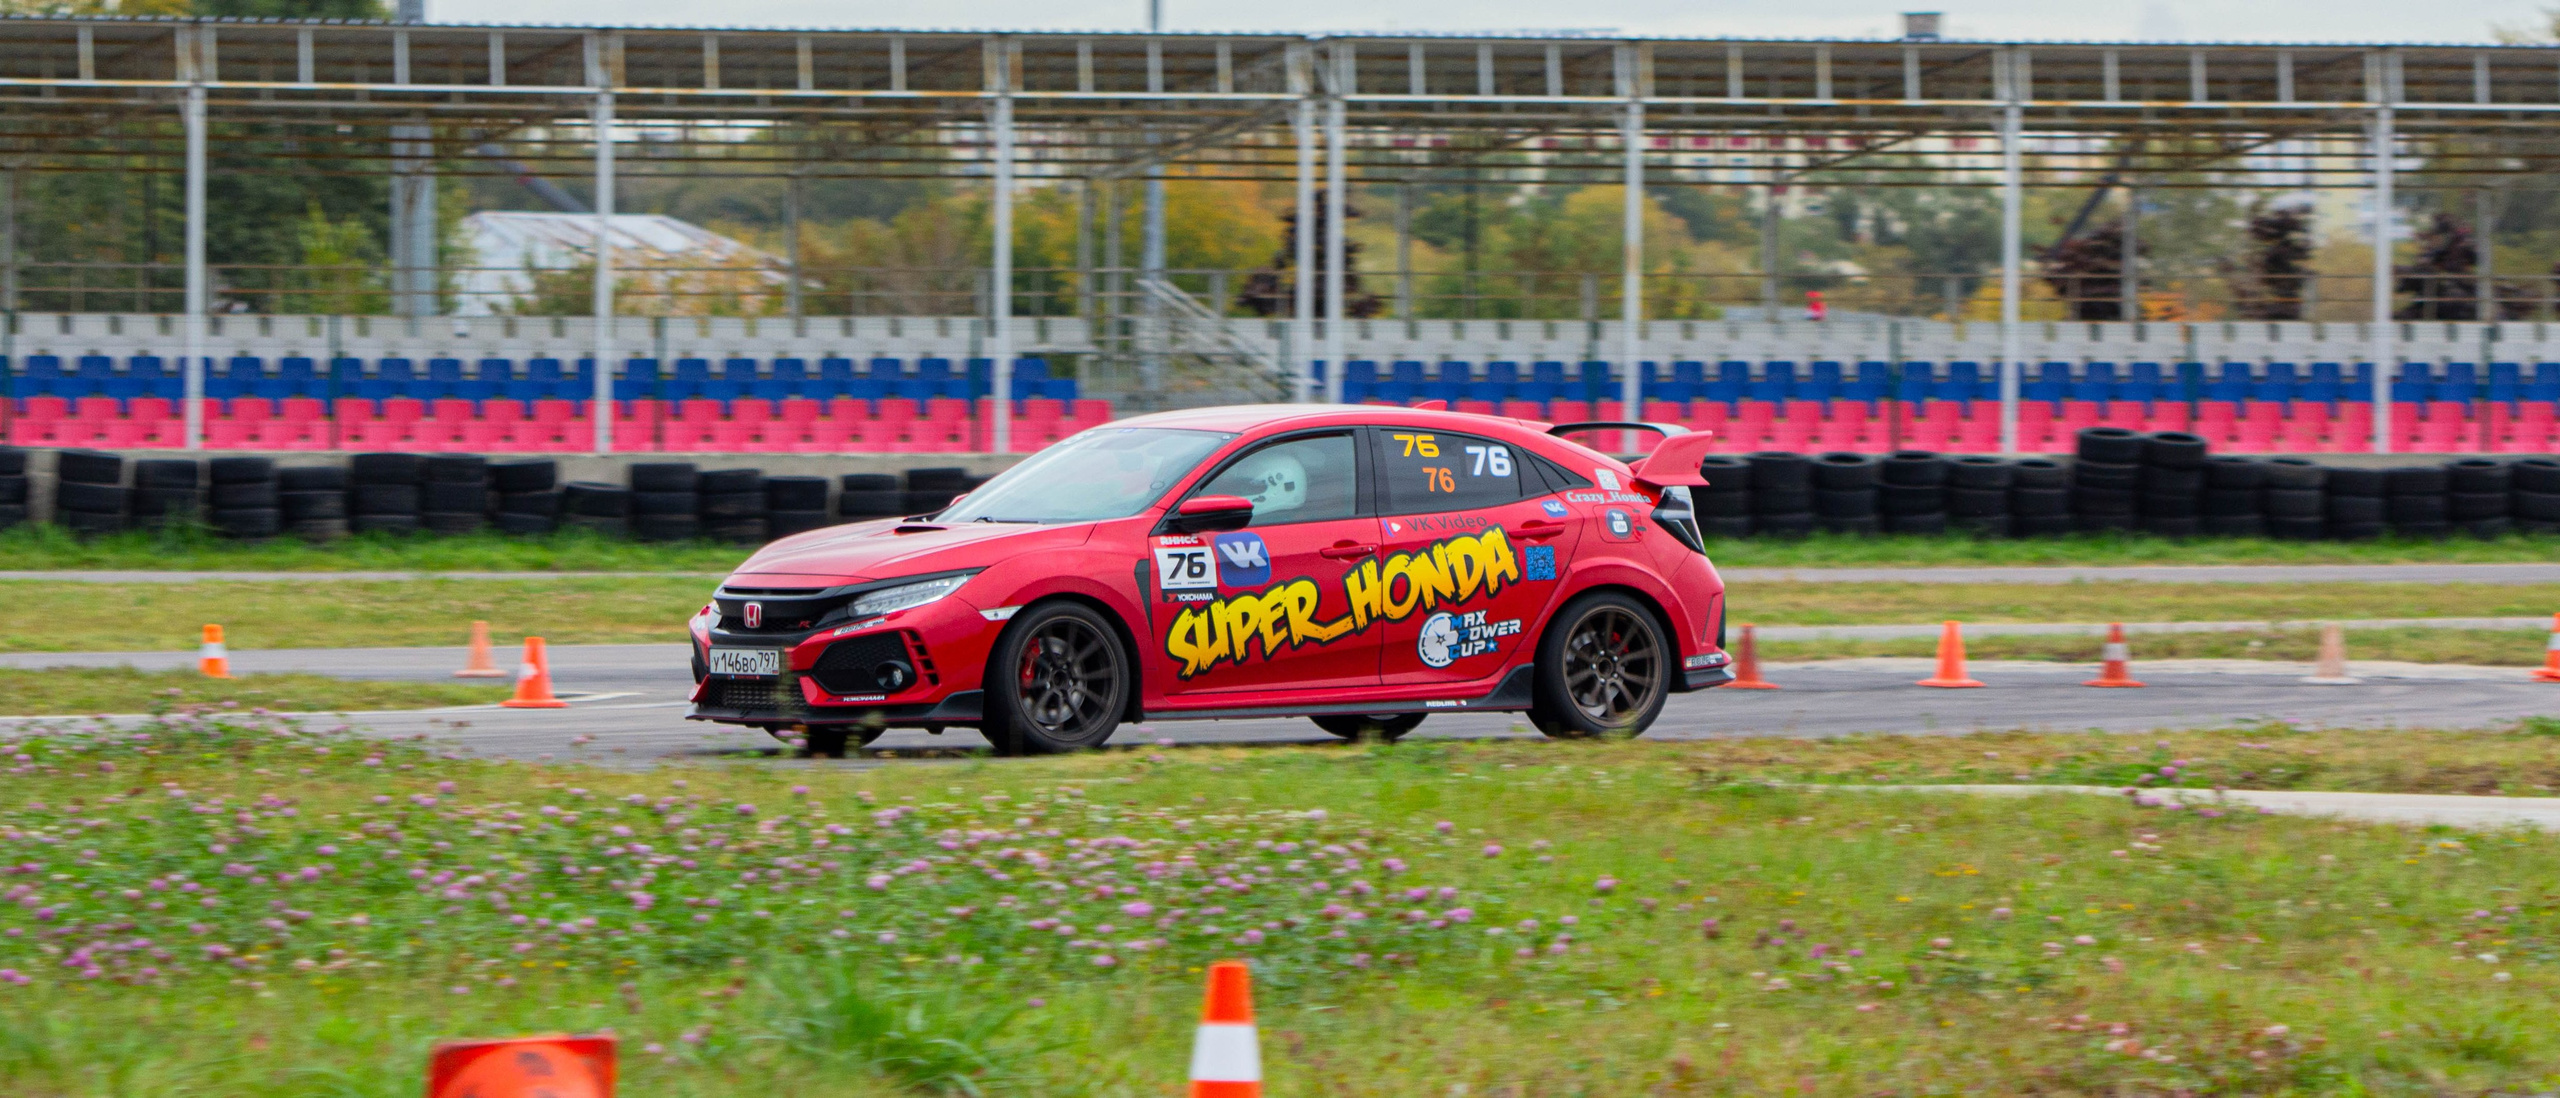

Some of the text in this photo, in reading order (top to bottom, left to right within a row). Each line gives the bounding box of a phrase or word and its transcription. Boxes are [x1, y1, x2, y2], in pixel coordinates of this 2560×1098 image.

[1393, 434, 1440, 457] 76
[1465, 446, 1512, 477] 76
[1421, 467, 1456, 493] 76
[1404, 514, 1488, 532] VK Video
[1167, 552, 1207, 580] 76
[1218, 541, 1267, 568] VK
[1177, 593, 1214, 602] YOKOHAMA
[1450, 609, 1487, 630] MAX
[1458, 619, 1521, 642] POWER
[758, 652, 776, 667] 797
[1448, 640, 1486, 660] CUP
